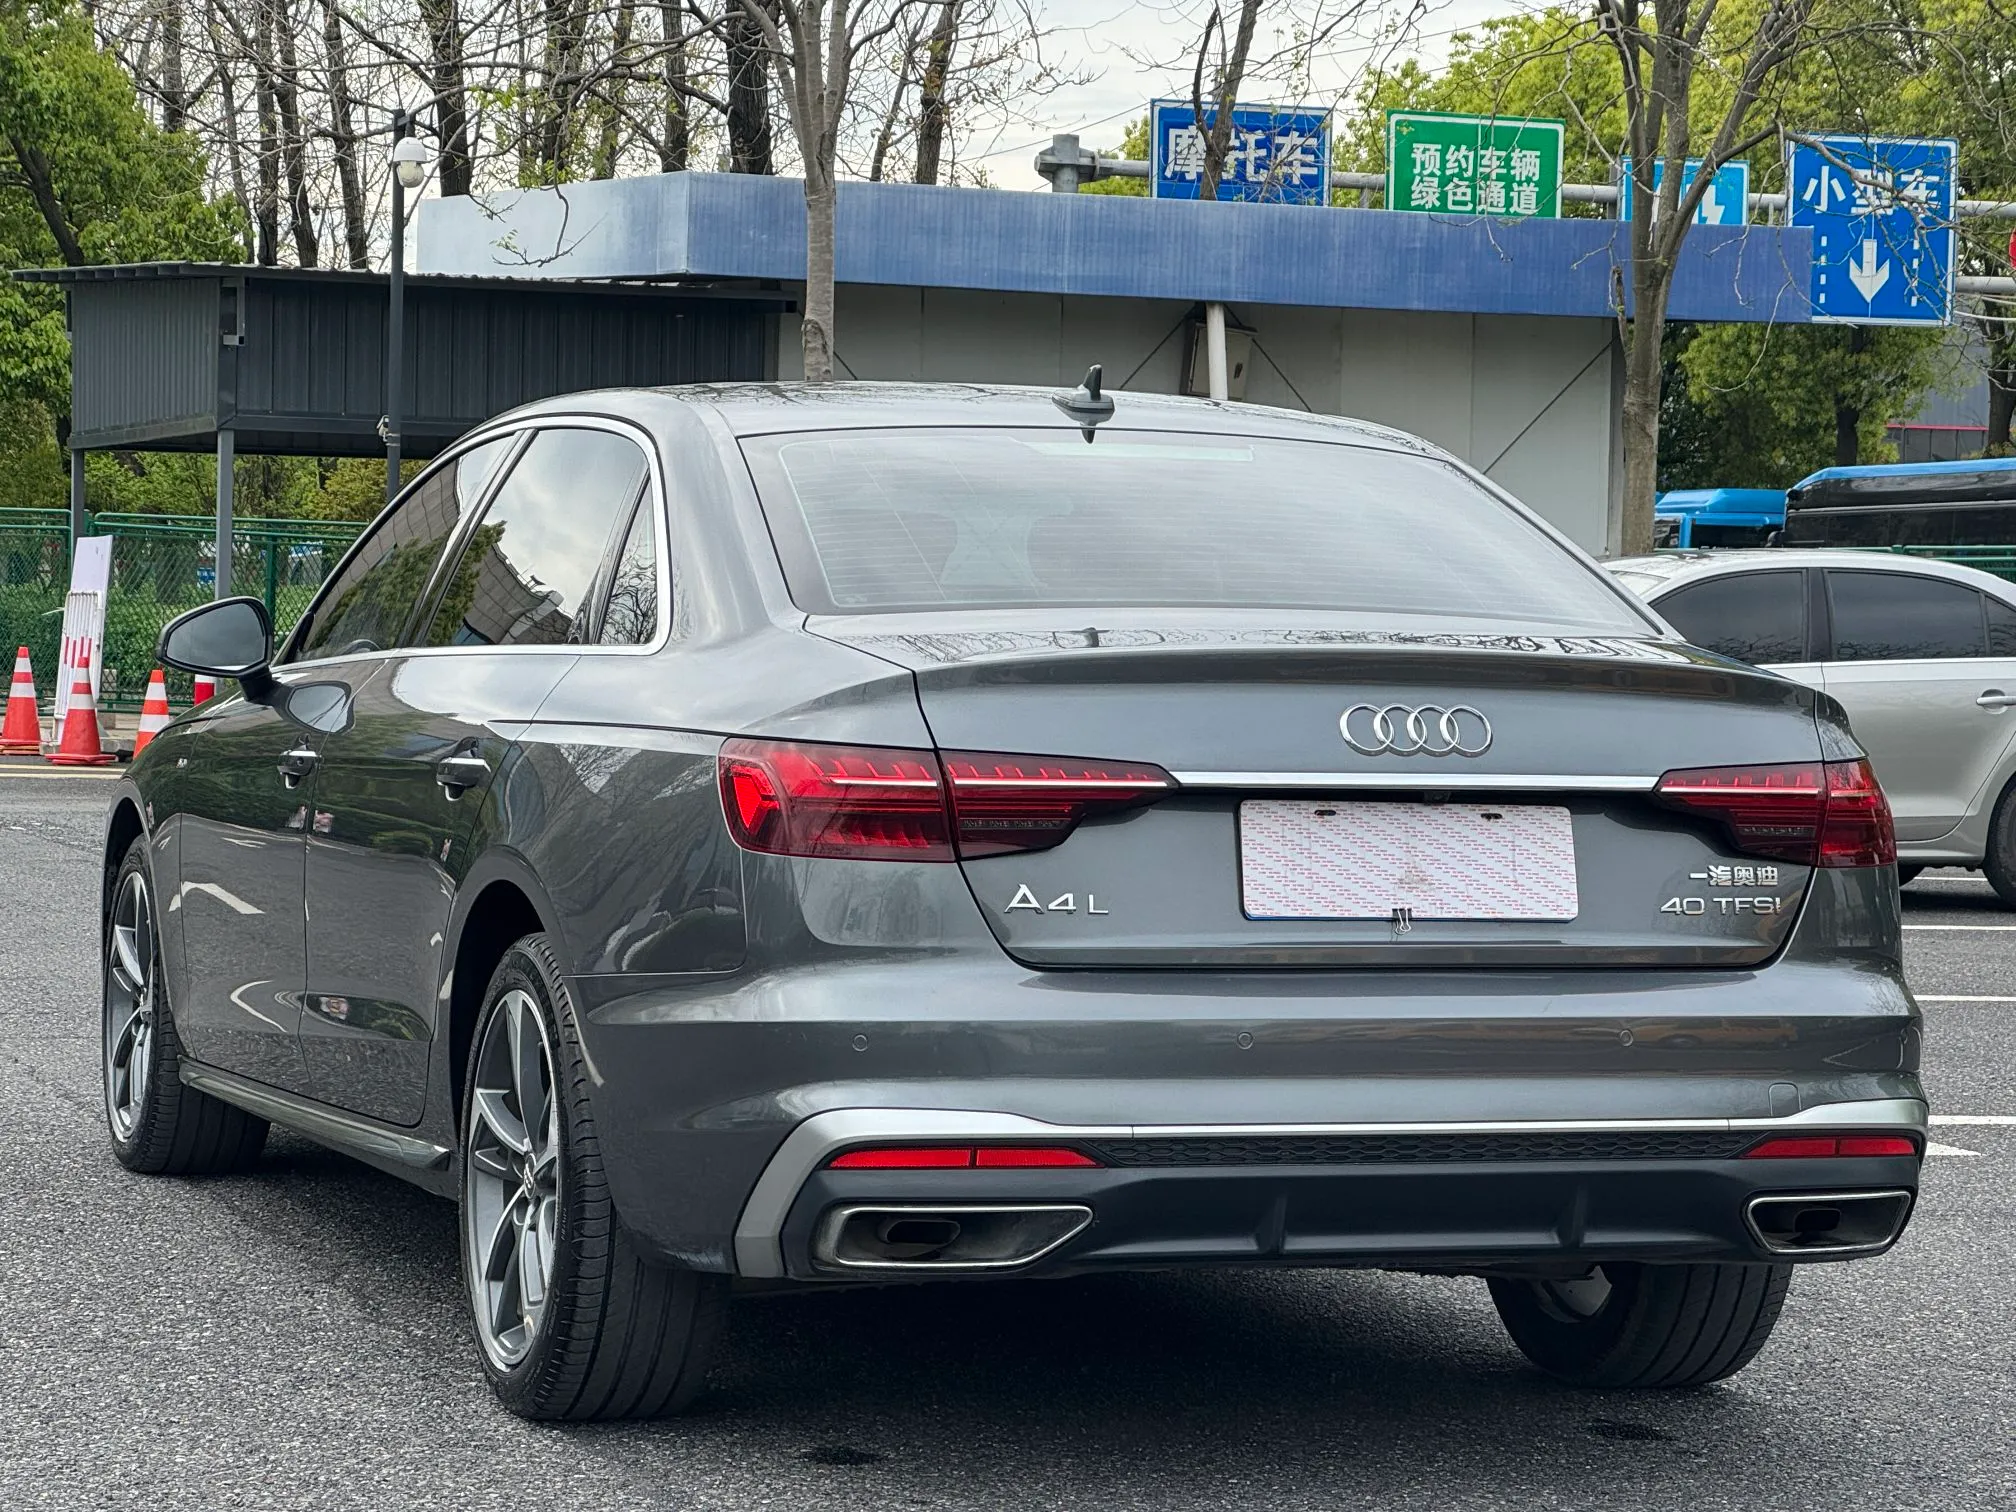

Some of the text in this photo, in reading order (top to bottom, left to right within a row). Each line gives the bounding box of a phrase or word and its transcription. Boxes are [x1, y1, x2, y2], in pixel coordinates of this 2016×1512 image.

[1164, 125, 1319, 185] 摩托车
[1411, 143, 1541, 181] 预约车辆
[1410, 176, 1539, 214] 绿色通道
[1802, 165, 1942, 218] 小型车
[1689, 865, 1779, 886] 一汽奥迪
[1660, 897, 1781, 915] 40 TFSI
